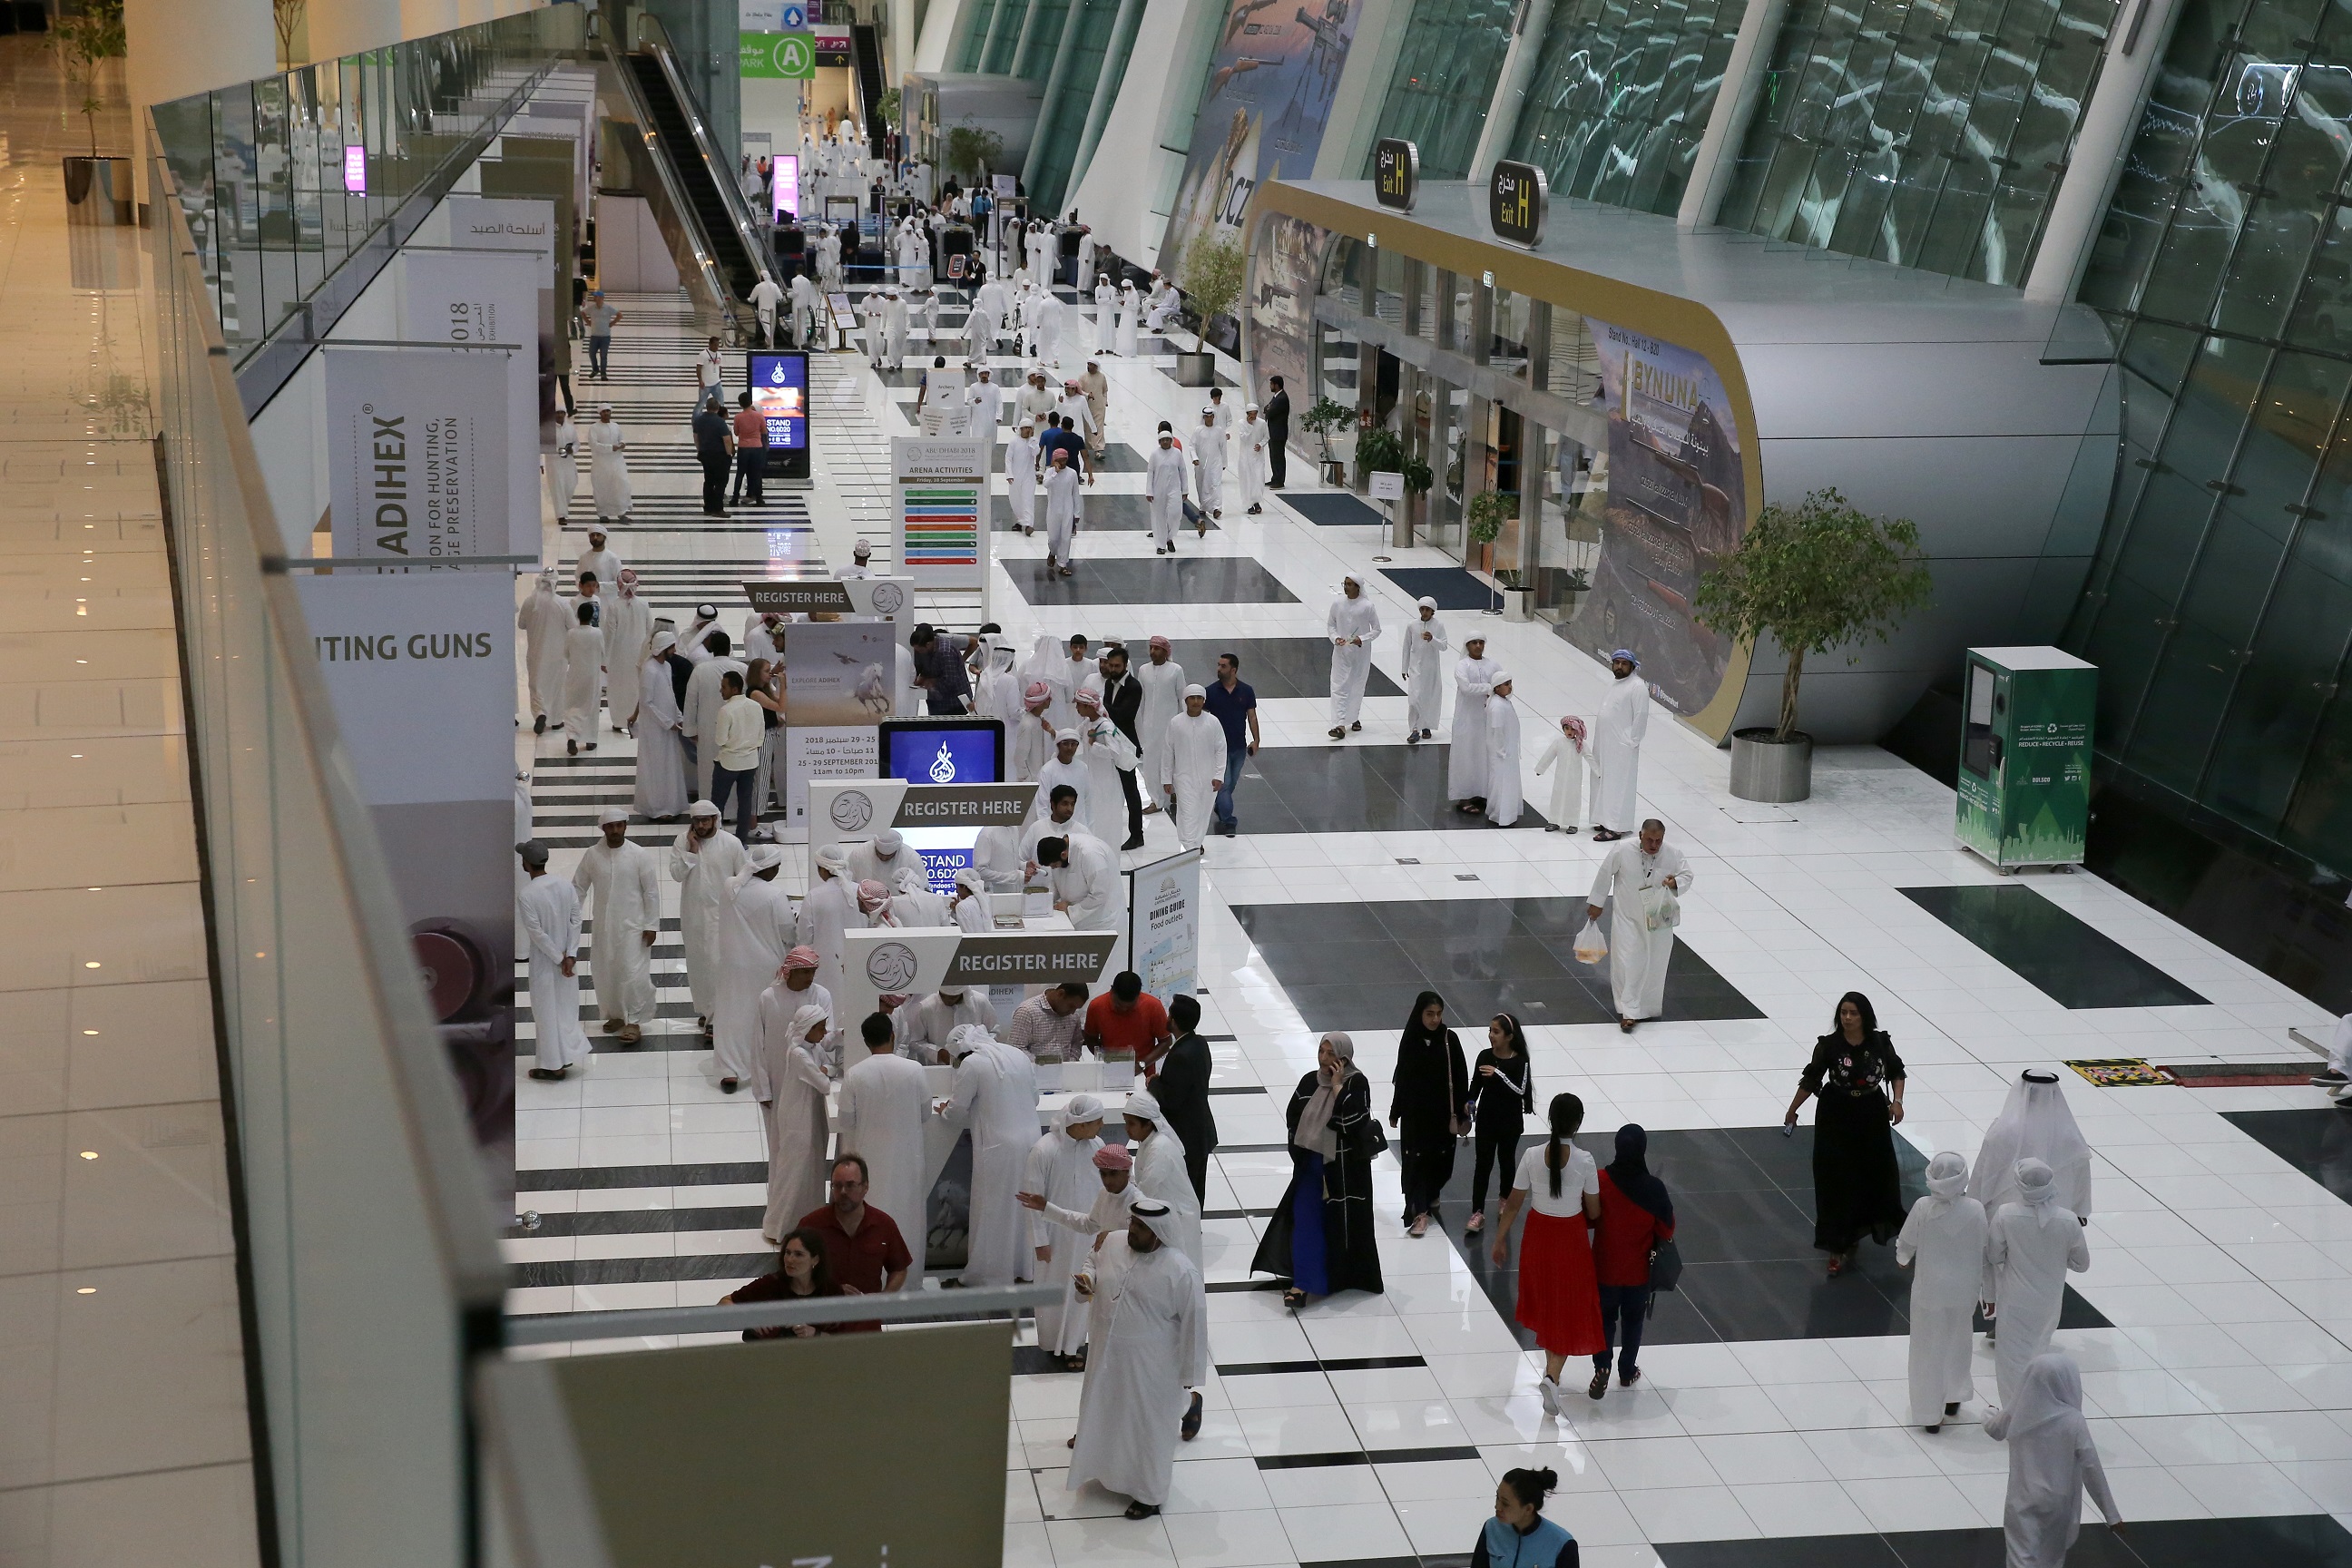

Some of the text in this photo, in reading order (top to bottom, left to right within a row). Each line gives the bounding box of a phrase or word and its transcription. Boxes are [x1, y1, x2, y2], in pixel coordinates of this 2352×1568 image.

[782, 44, 800, 66] A
[1380, 149, 1394, 168] مخرج
[1383, 174, 1394, 193] Exit
[1396, 152, 1404, 196] H
[1498, 172, 1515, 195] مخرج
[1501, 202, 1514, 225] Exit
[1517, 179, 1529, 229] H
[470, 222, 545, 236] أسلحة الصيد
[488, 303, 496, 341] EXHIBITION
[1608, 327, 1622, 343] Stand
[1632, 336, 1641, 349] Hall
[1634, 359, 1699, 410] BYNUNA
[372, 416, 408, 556] ADIHEX
[445, 416, 460, 534] PRESERVATION
[426, 417, 442, 571] TON FOR HUNTING,
[755, 592, 845, 603] REGISTER HERE
[407, 632, 492, 660] GUNS
[845, 768, 865, 776] 10pm
[904, 800, 1023, 816] REGISTER HERE
[919, 855, 965, 867] STAND
[926, 868, 958, 879] O.6D2
[1150, 899, 1185, 921] DINING GUIDE
[1151, 913, 1183, 931] Food outlets
[958, 953, 1099, 972] REGISTER HERE
